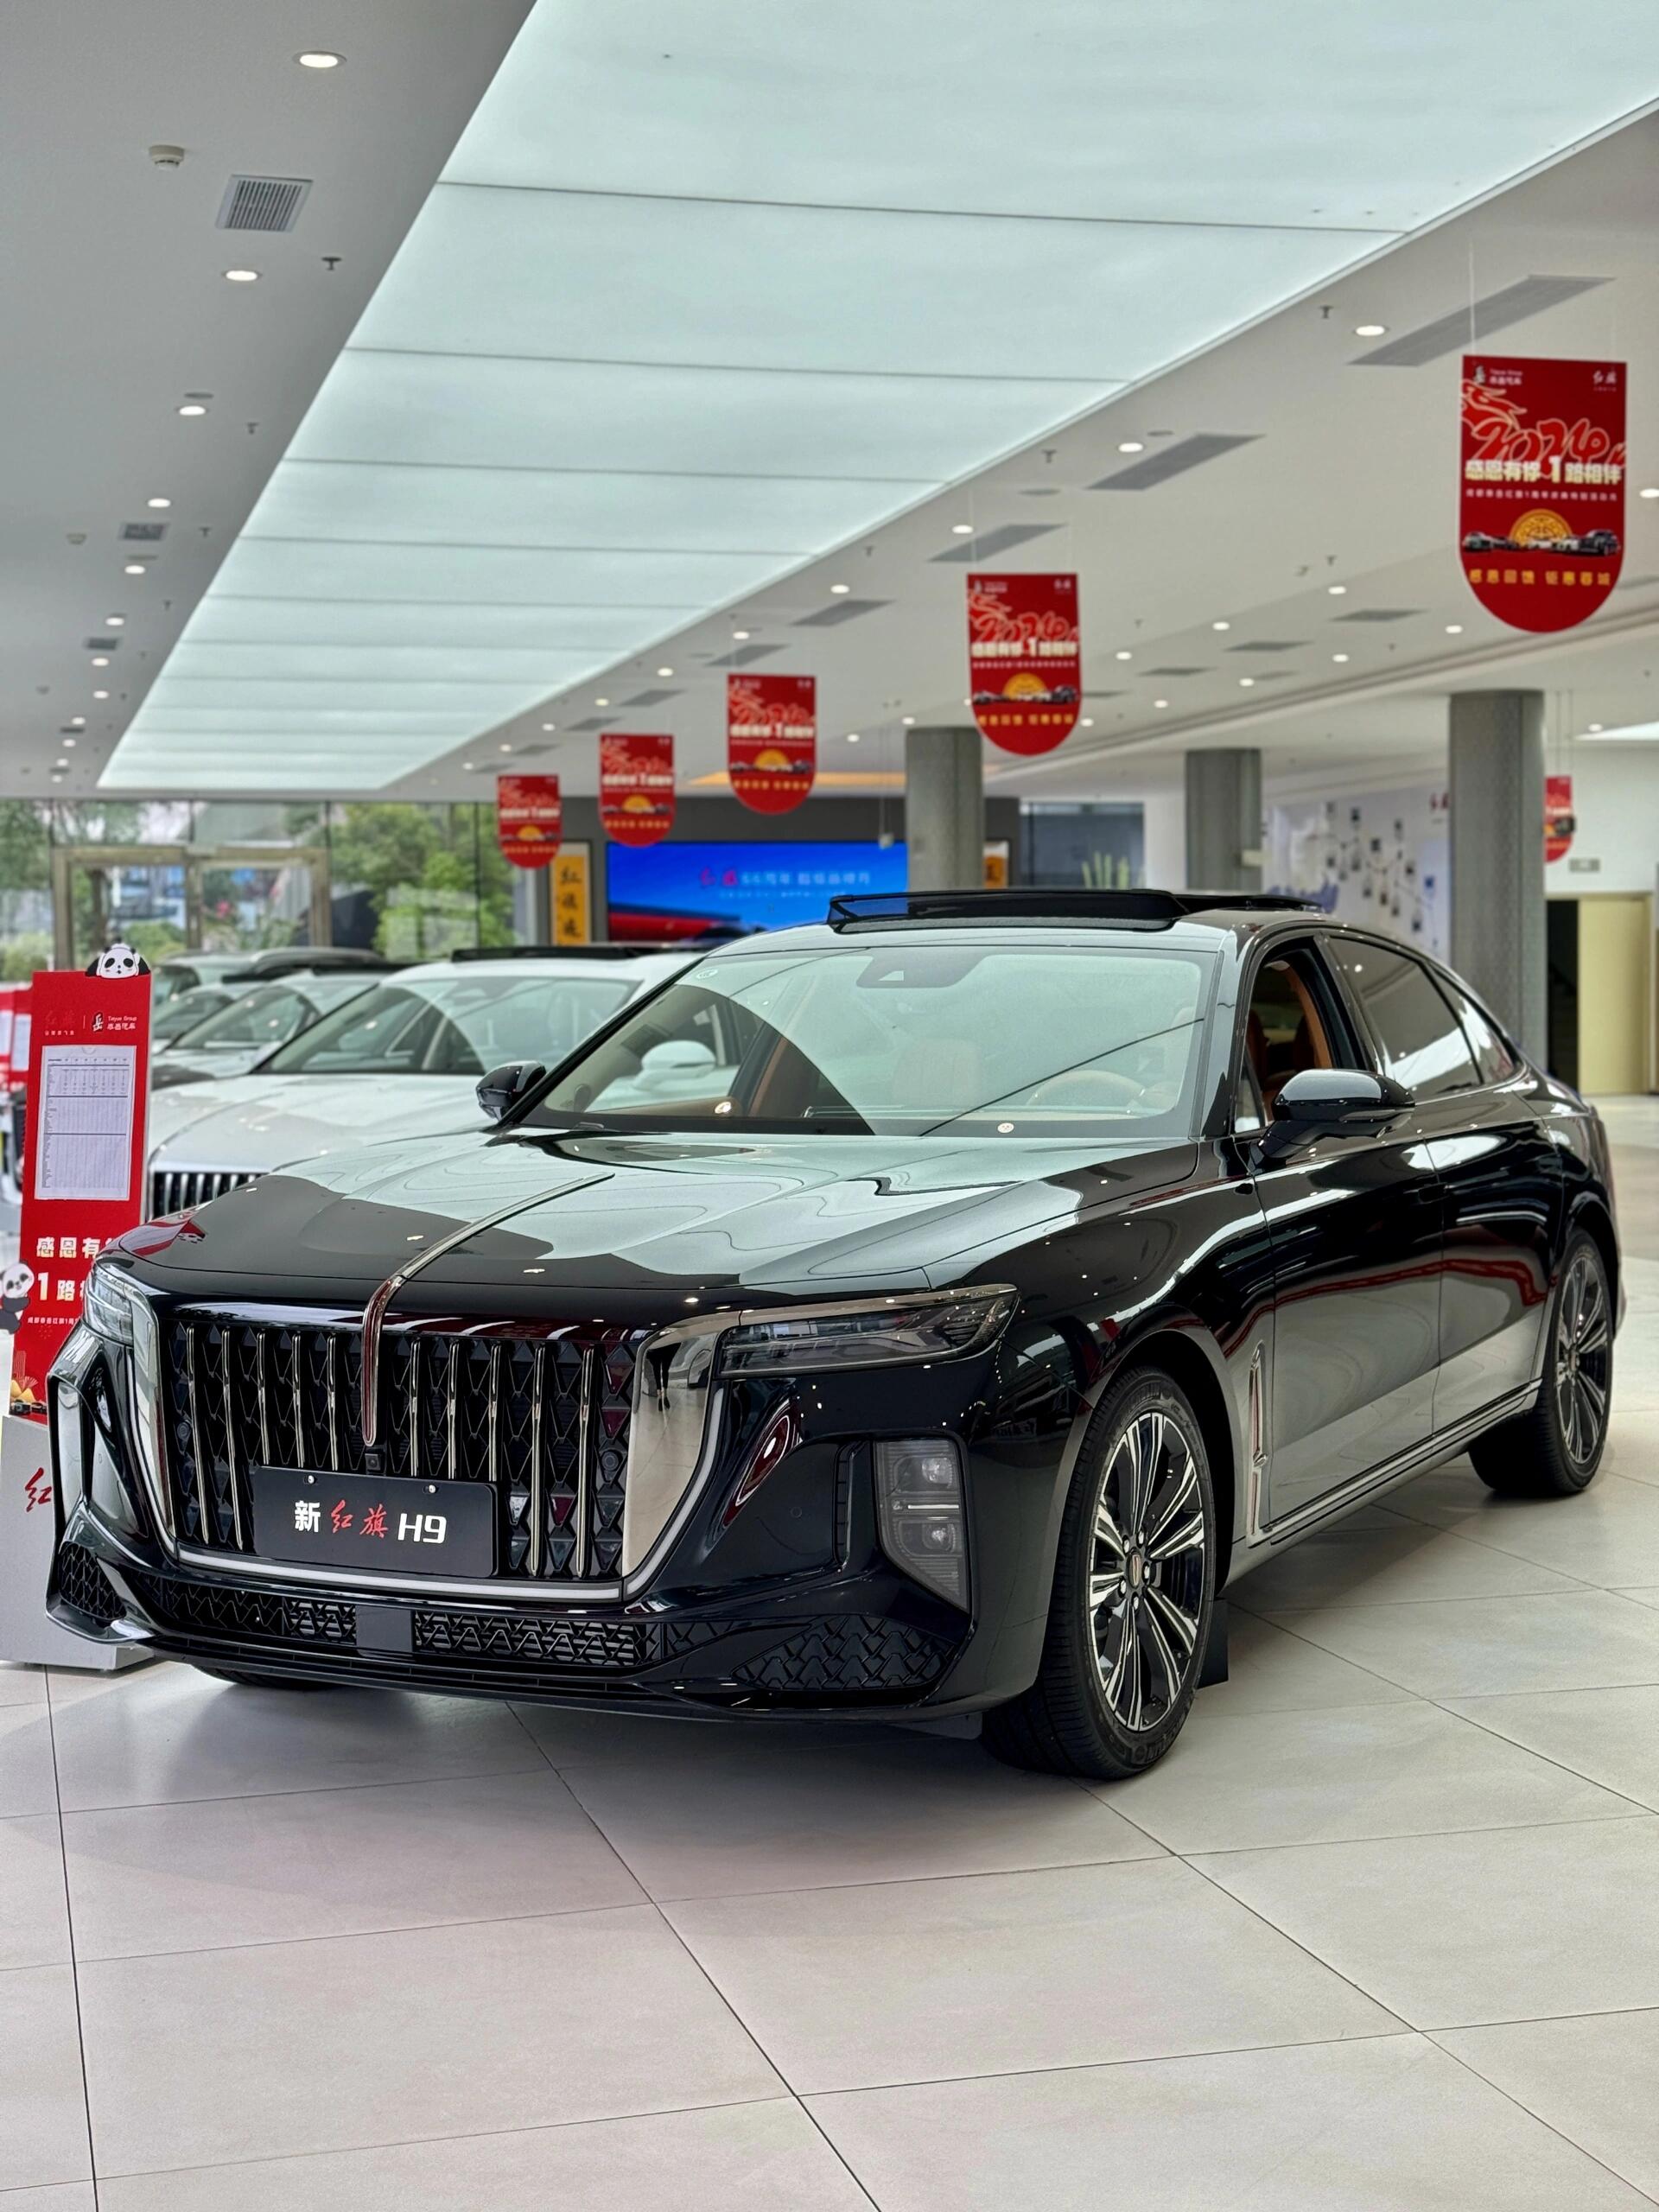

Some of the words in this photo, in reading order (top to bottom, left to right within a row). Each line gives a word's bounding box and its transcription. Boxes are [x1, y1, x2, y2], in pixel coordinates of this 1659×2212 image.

[36, 1237, 112, 1259] 感恩有
[37, 1272, 85, 1301] 1路
[397, 1513, 448, 1543] H9
